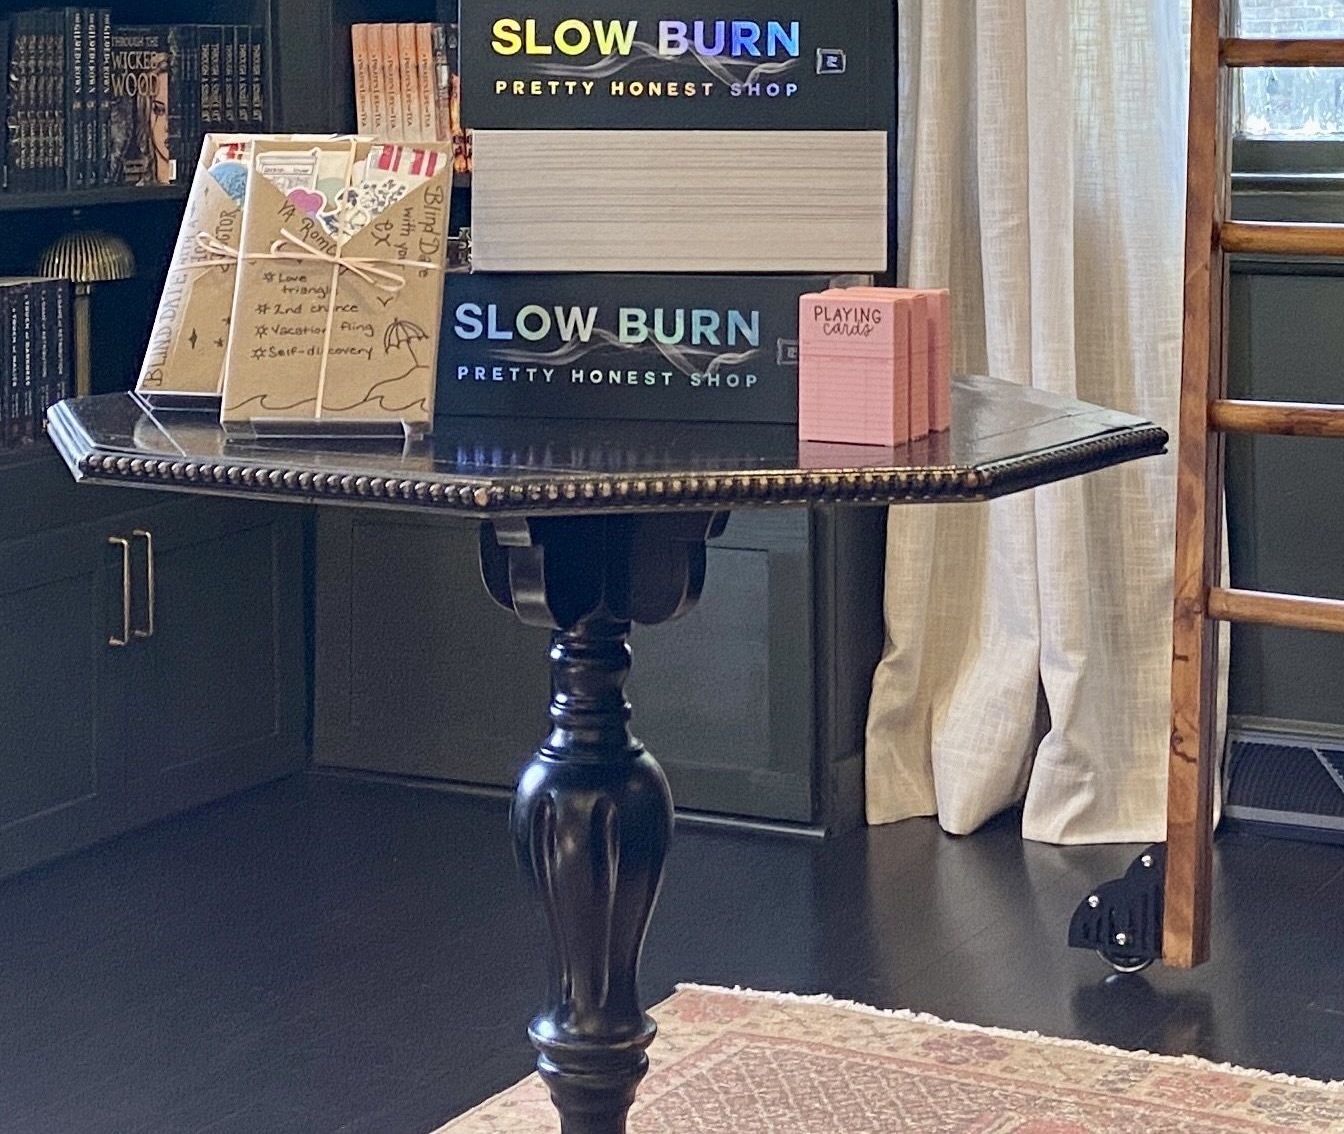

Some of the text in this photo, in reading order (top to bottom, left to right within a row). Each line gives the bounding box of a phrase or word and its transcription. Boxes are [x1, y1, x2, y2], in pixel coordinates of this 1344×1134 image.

[112, 37, 144, 48] THROUGH
[490, 19, 801, 58] SLOW BURN
[112, 73, 159, 97] WOOD
[495, 80, 800, 98] PRETTY HONEST SHOP
[277, 199, 296, 223] YA
[404, 207, 415, 236] with
[418, 185, 444, 278] Blind Dae
[279, 273, 307, 282] Love
[282, 286, 338, 298] triangl
[274, 304, 359, 315] 2nd chnce
[813, 305, 883, 324] PLAYING
[143, 325, 172, 387] BLIND
[159, 274, 187, 324] DATE
[454, 303, 761, 347] SLOW BURN
[822, 320, 875, 338] cards
[269, 346, 373, 360] Self-dicovery
[457, 367, 759, 388] PRETTY HONEST SHOP
